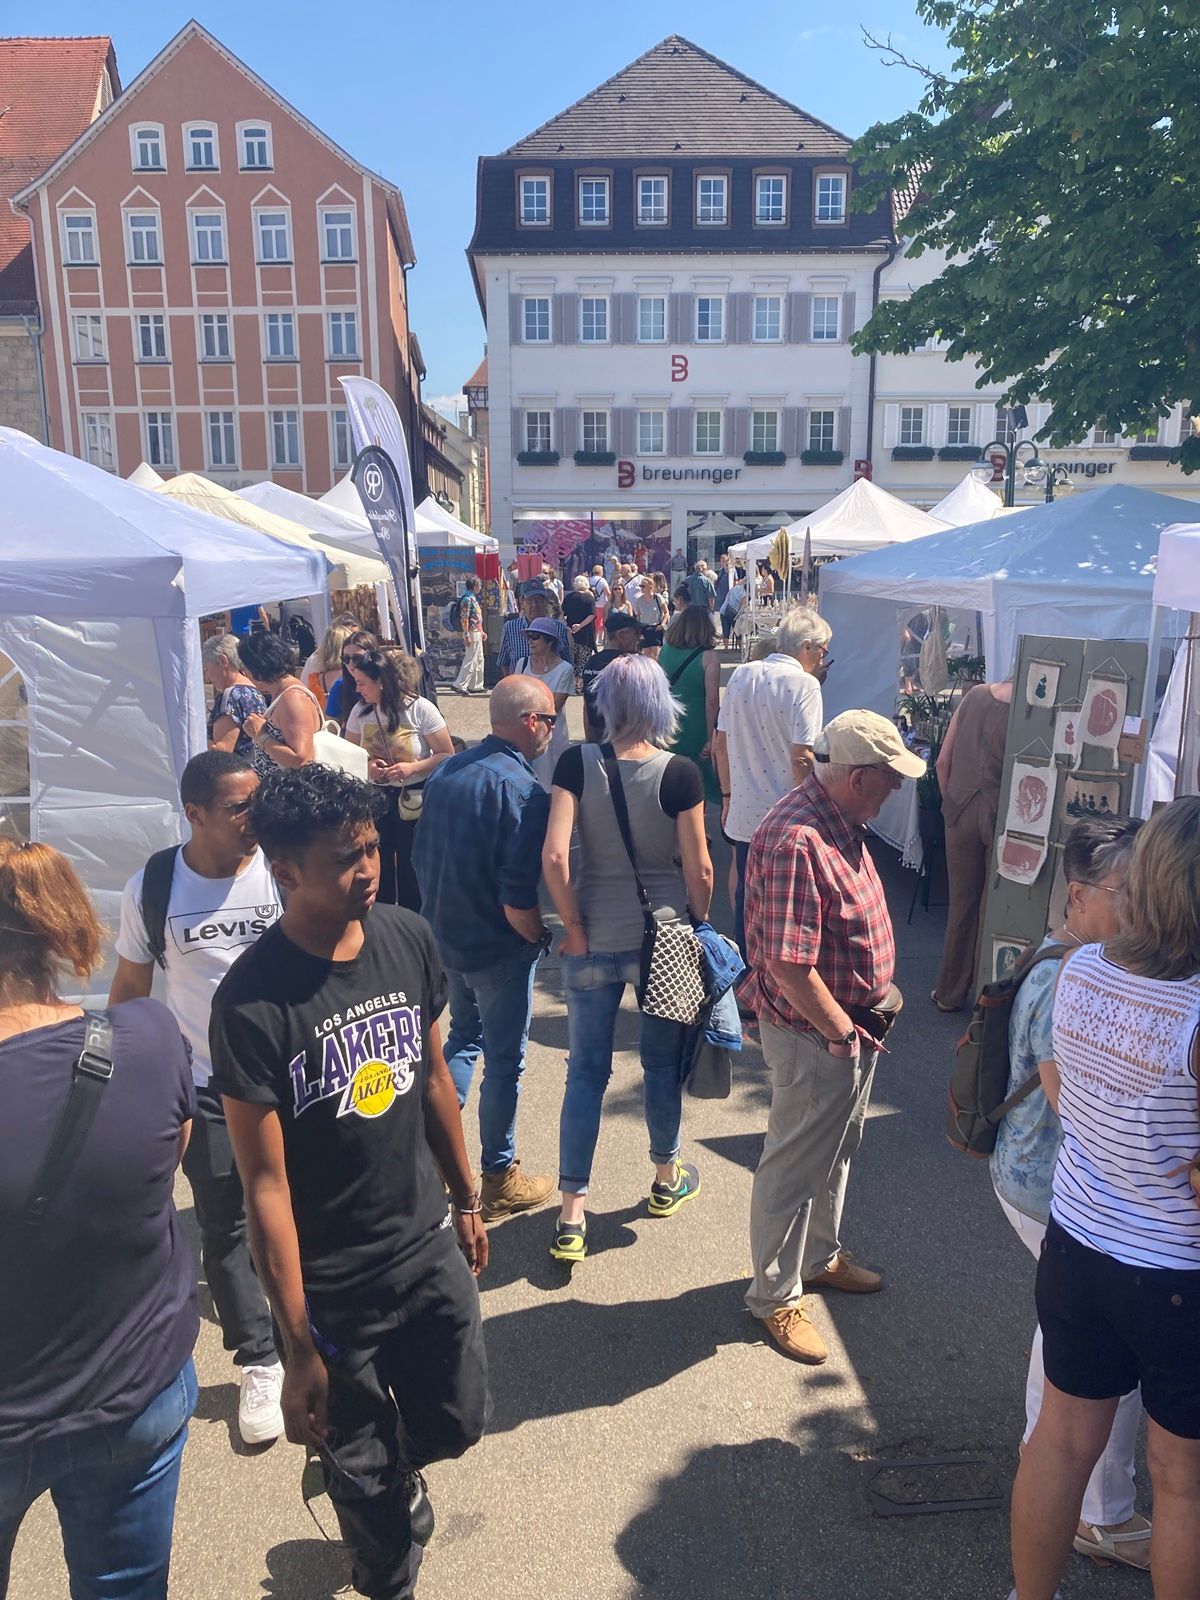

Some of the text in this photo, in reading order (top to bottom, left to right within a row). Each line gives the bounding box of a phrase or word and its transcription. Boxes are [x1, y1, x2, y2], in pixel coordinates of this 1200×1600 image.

[642, 465, 742, 484] breuninger
[1046, 462, 1117, 477] uninger
[314, 991, 407, 1038] LOS ANGELES
[344, 1067, 407, 1111] LAKERS
